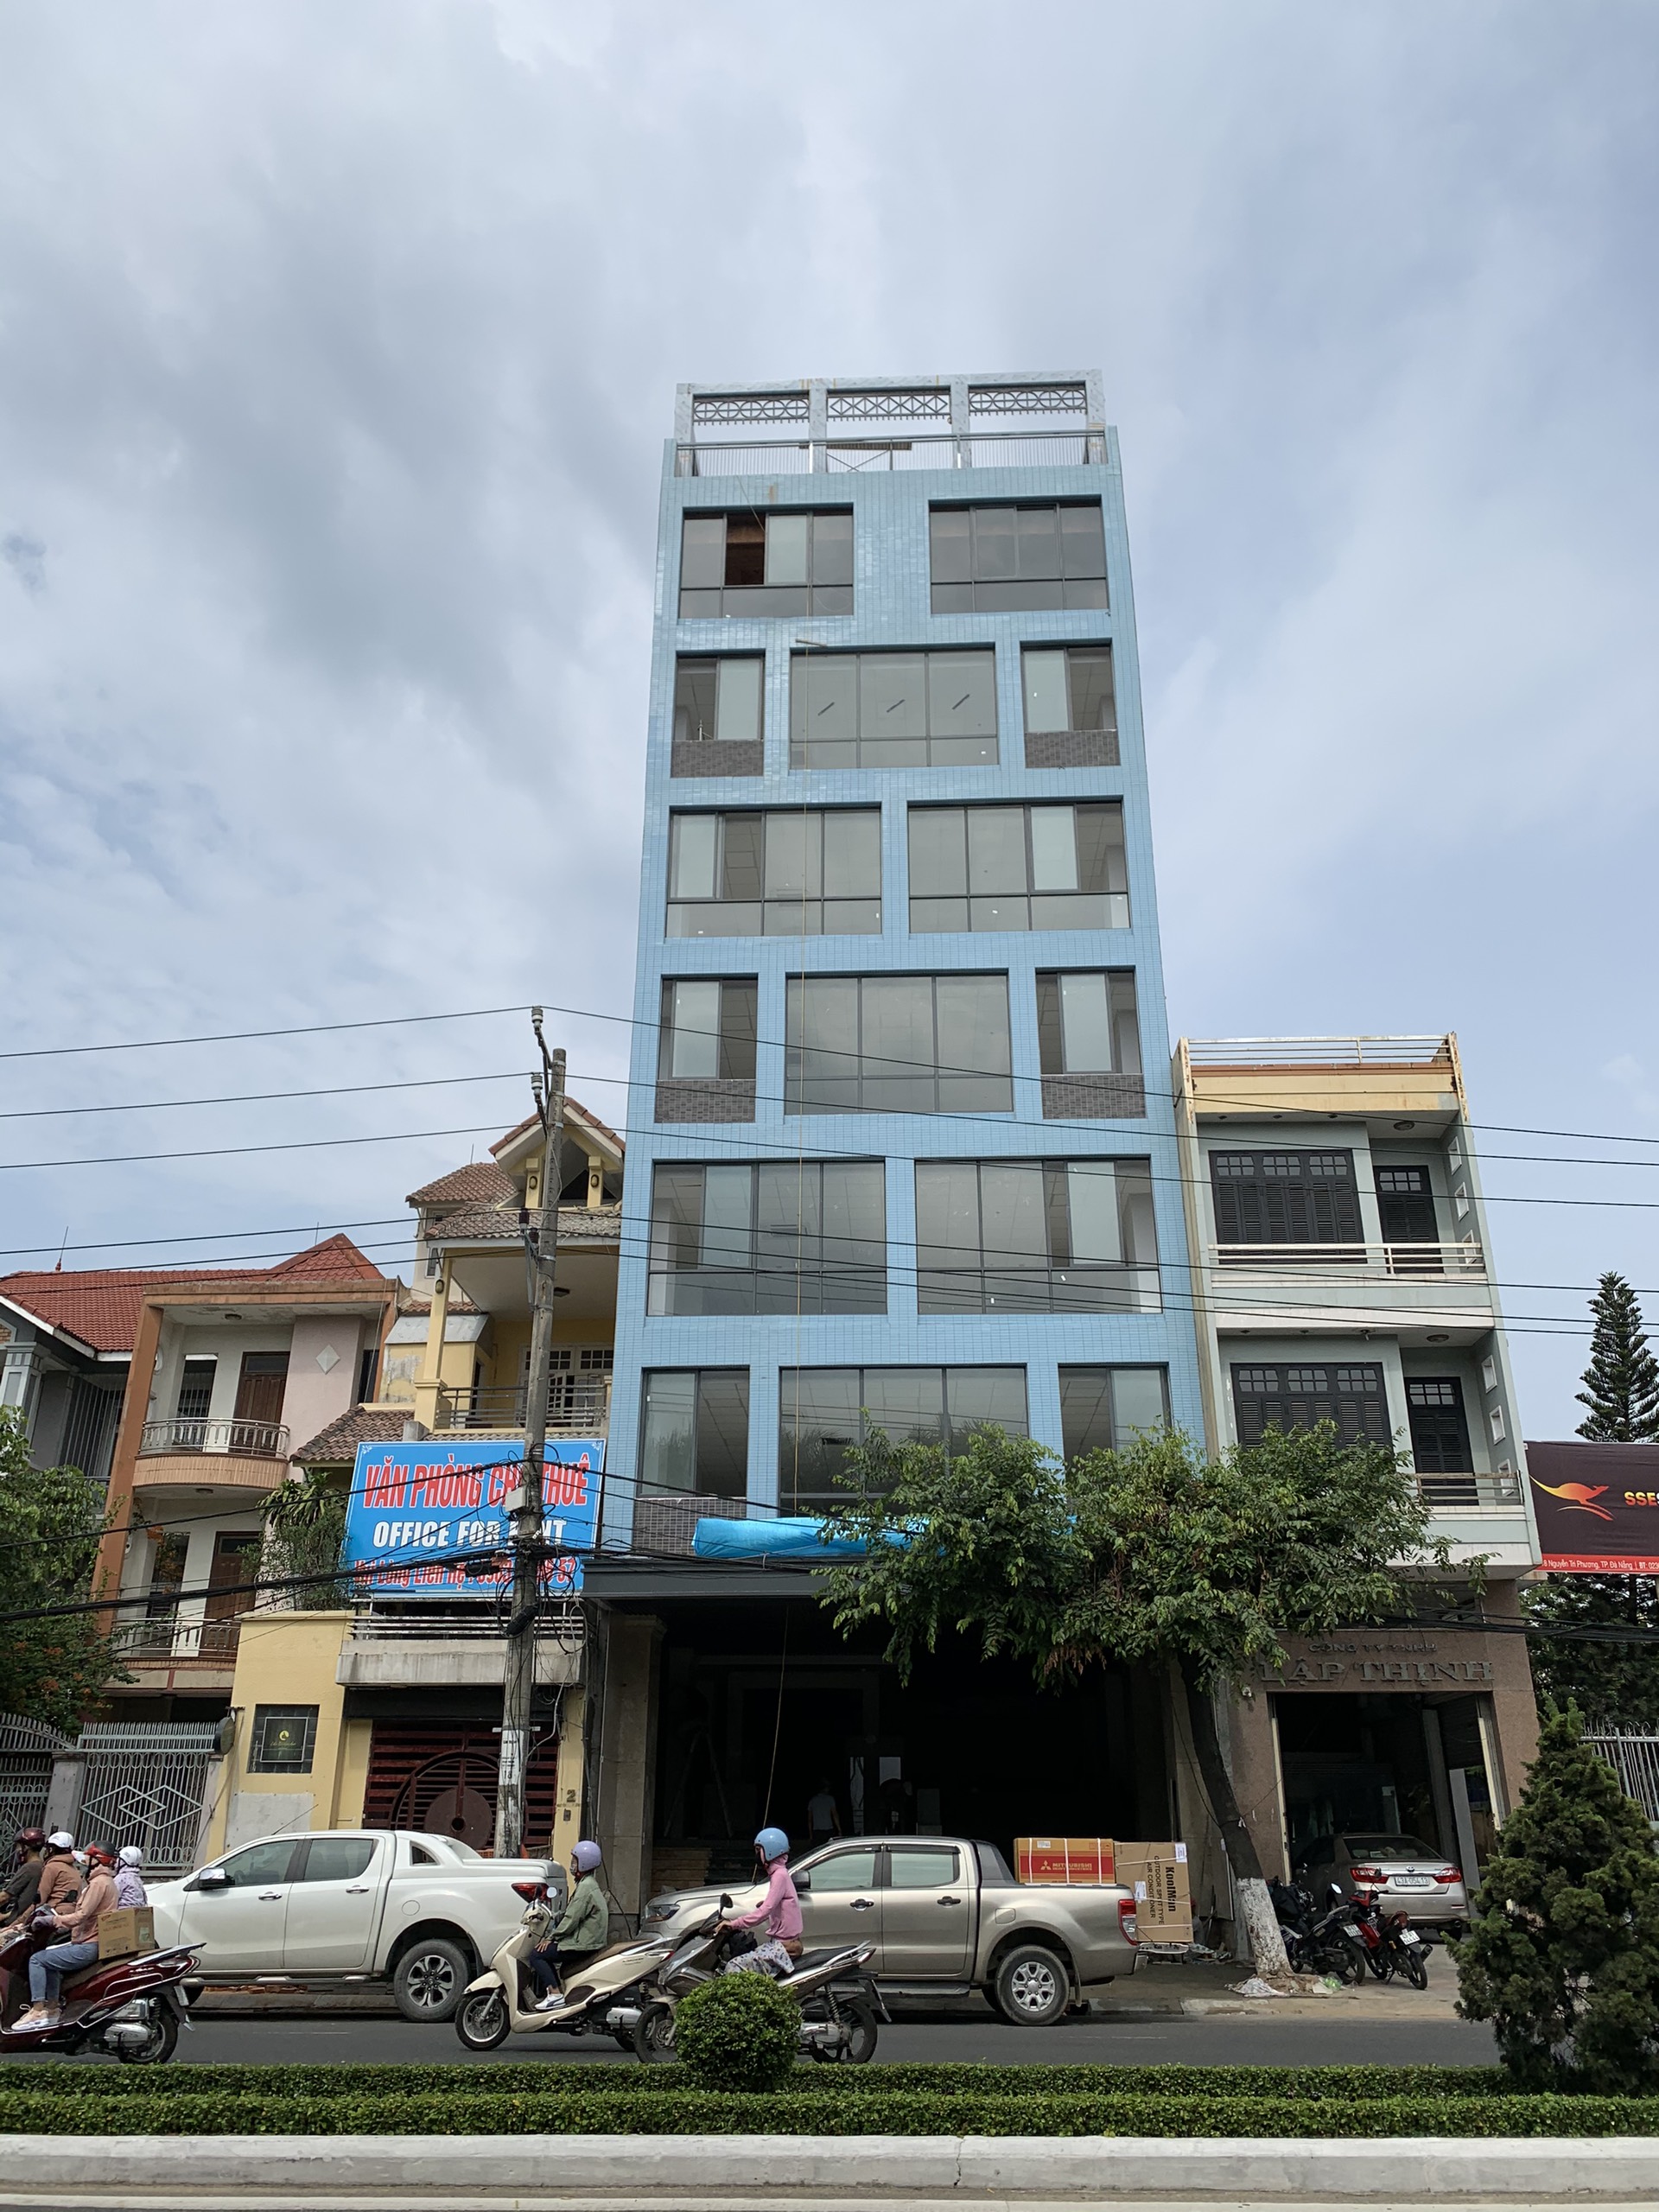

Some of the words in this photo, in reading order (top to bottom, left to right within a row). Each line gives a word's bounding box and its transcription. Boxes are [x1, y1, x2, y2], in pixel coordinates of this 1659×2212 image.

[364, 1455, 410, 1508] VĂN
[410, 1453, 483, 1508] PHÒNG
[1624, 1491, 1659, 1506] SSE
[373, 1521, 451, 1548] OFFICE
[457, 1521, 500, 1548] FOR
[1353, 1662, 1495, 1685] THỊNH
[1154, 1855, 1162, 1887] OUTDOOR
[1147, 1874, 1156, 1919] CONDITONER
[1166, 1866, 1176, 1911] KoolMan
